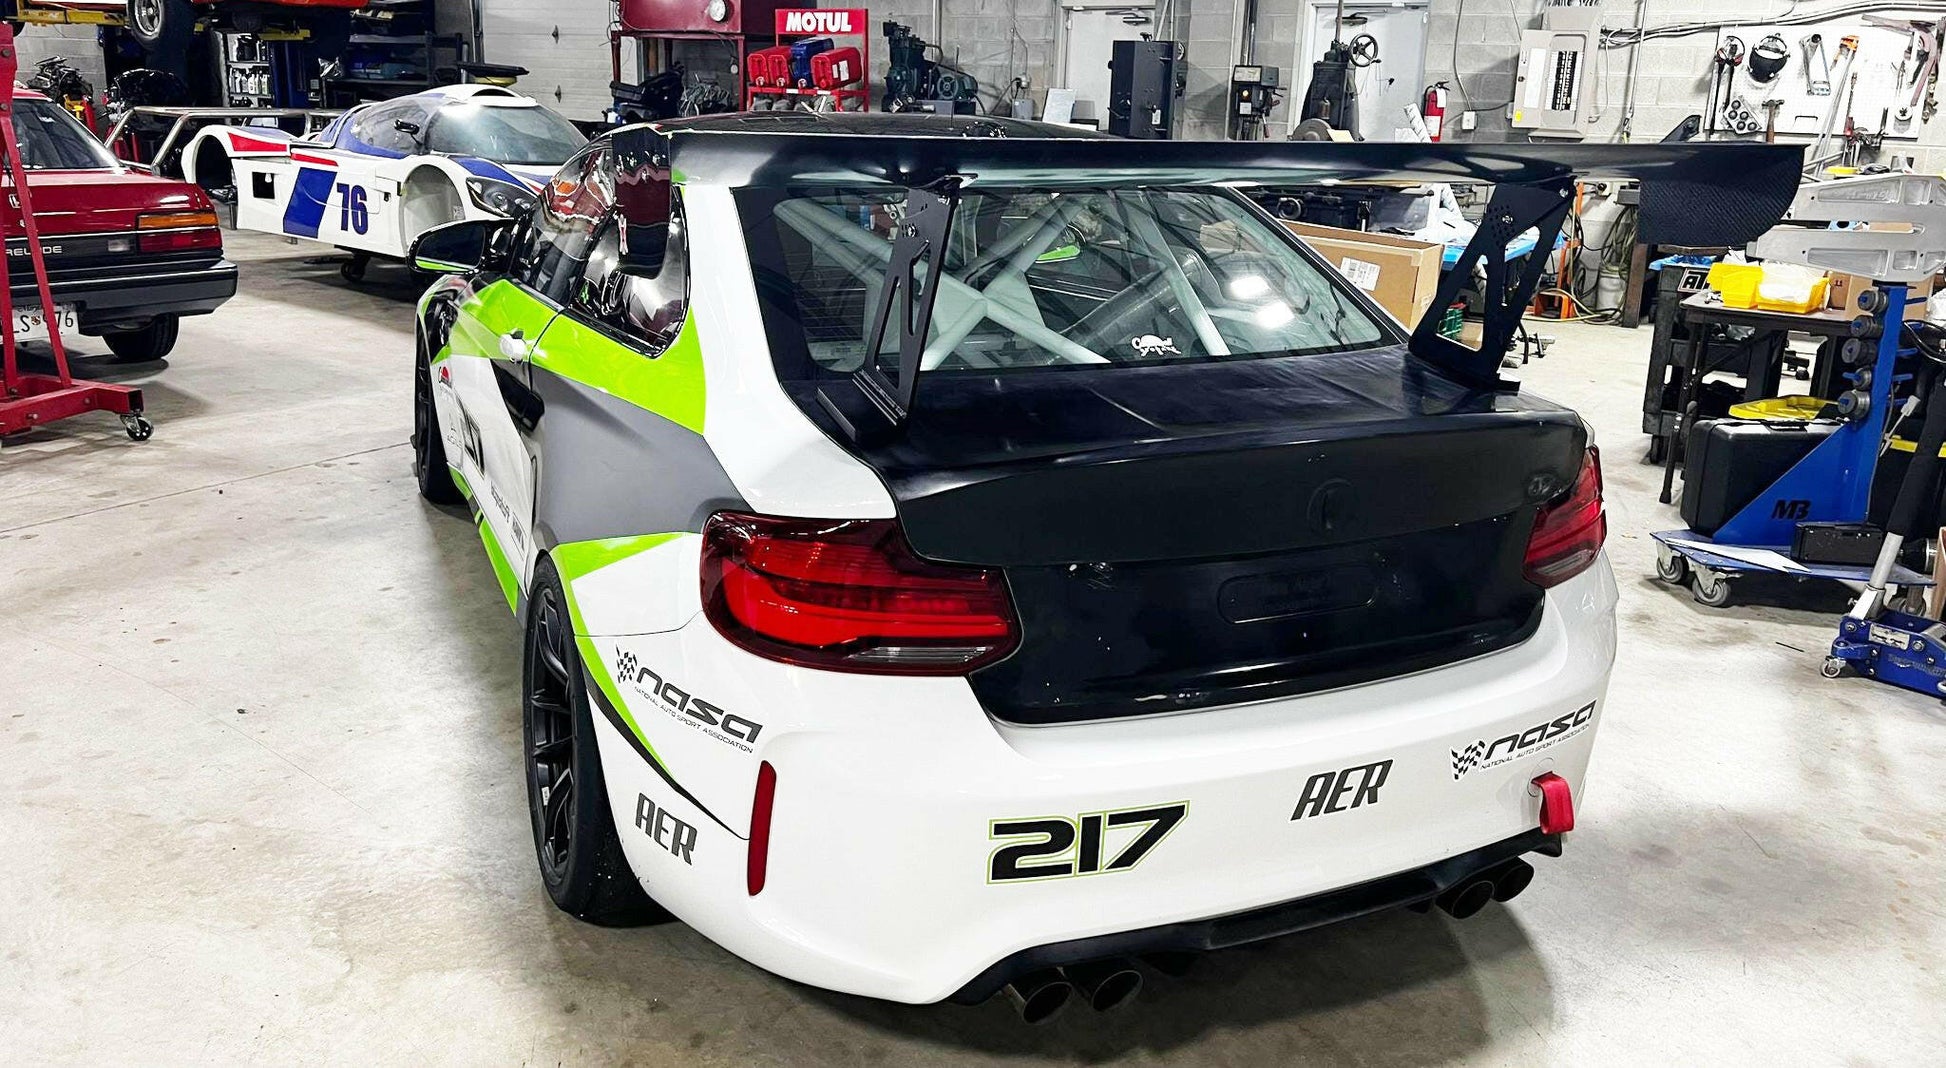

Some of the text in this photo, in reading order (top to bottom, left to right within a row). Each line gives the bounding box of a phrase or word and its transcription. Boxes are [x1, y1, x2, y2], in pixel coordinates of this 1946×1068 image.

[786, 11, 852, 32] MOTUL
[337, 183, 368, 235] 76
[634, 686, 753, 753] NATIONAL AUTO SPORT ASSOCIATION
[1481, 722, 1590, 770] NATIONAL AUTO SPORT ASSOCIATION
[1290, 759, 1393, 821] AER
[635, 792, 698, 865] AER
[988, 802, 1188, 882] 217
